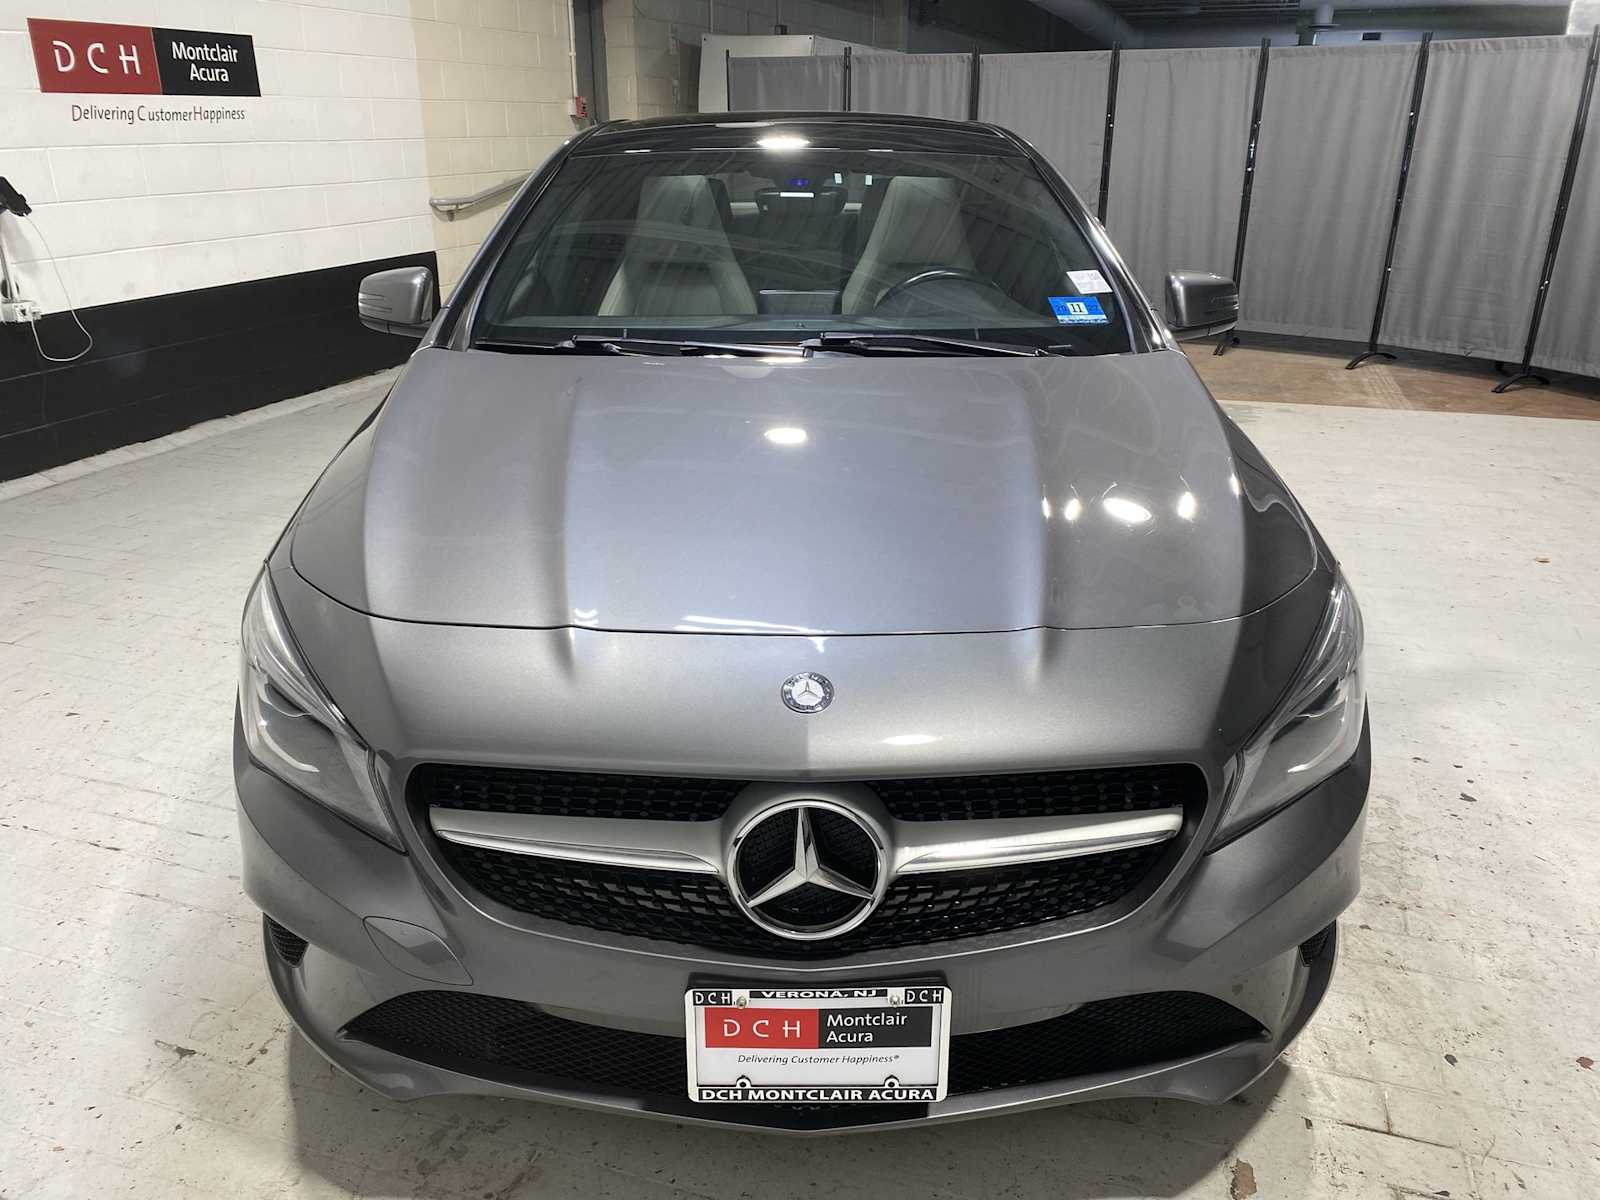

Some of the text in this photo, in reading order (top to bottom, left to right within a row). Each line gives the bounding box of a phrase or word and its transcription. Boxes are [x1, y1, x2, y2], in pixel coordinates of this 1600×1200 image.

[171, 41, 239, 63] Montclair
[189, 63, 230, 83] Acura
[71, 104, 246, 125] Delivering Customer Happiness
[1070, 303, 1083, 313] 11
[695, 991, 731, 1005] DCH
[761, 989, 878, 999] VERONA, NJ
[906, 989, 943, 1003] DCH
[826, 1012, 908, 1028] Montclair
[826, 1030, 873, 1043] Acura
[738, 1054, 788, 1065] Delivering
[791, 1055, 840, 1064] Customer
[702, 1088, 934, 1100] DCH MONTCLAIR ACURA
